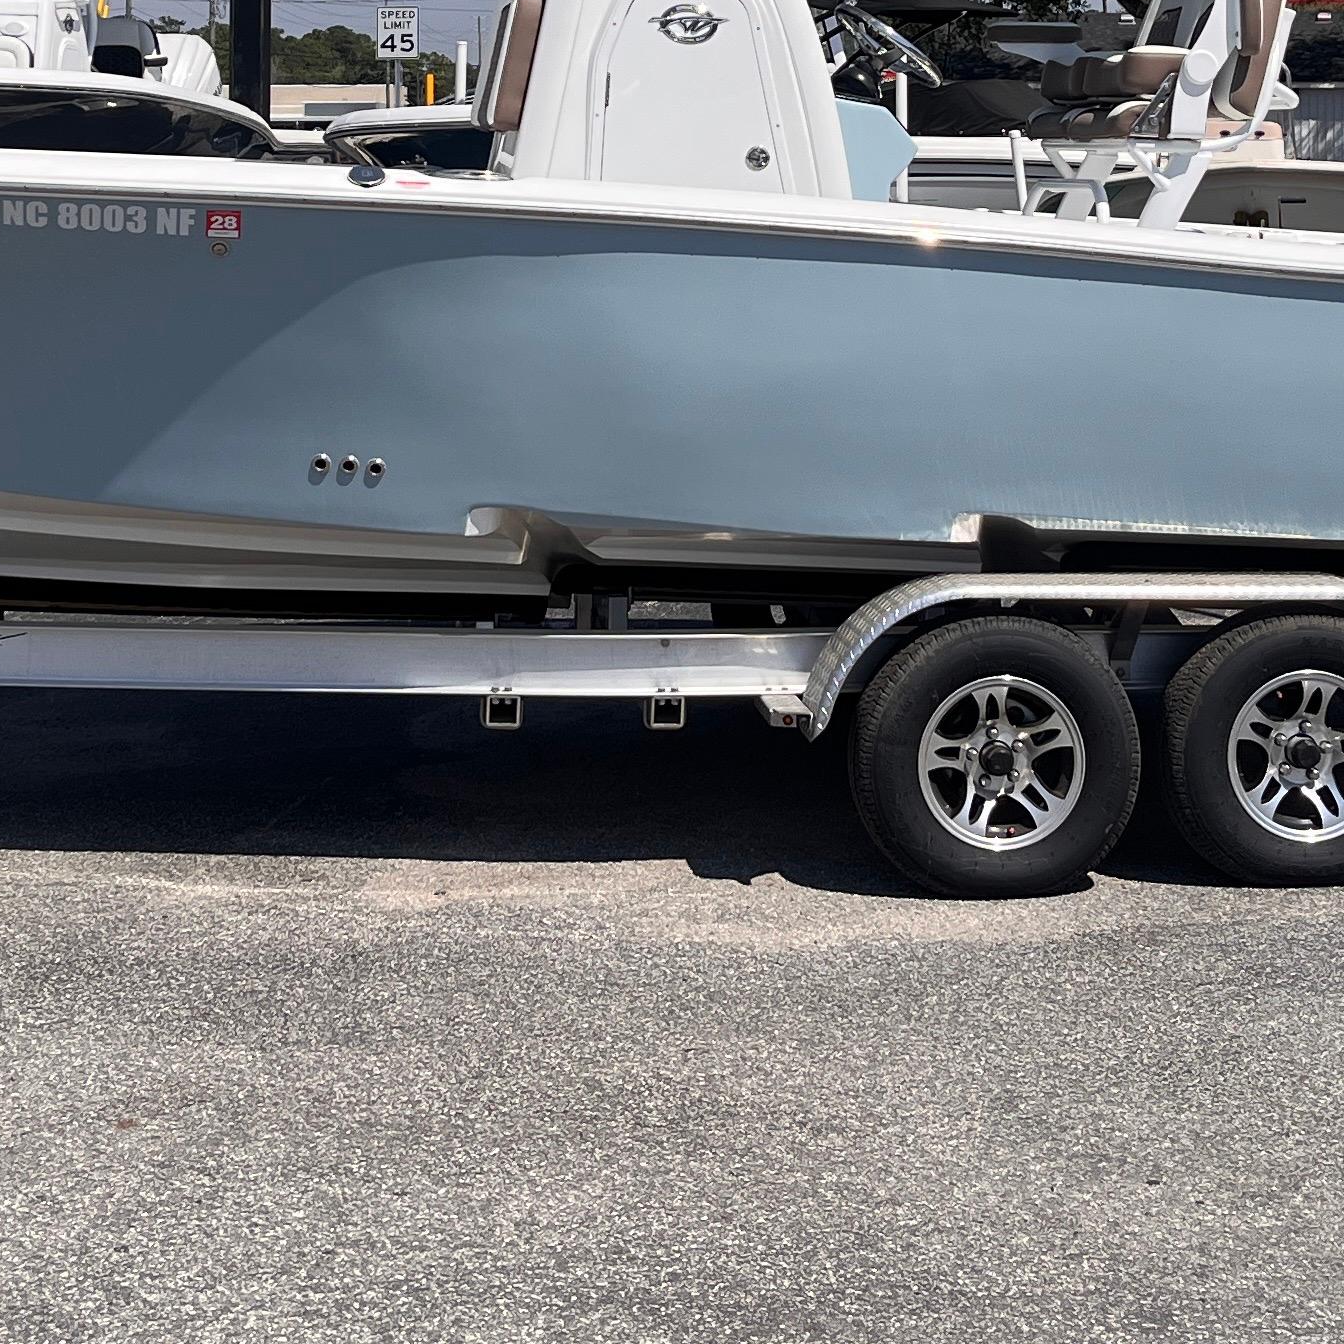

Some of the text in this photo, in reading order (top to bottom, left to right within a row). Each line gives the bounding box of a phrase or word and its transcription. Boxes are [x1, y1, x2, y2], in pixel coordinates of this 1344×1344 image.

[380, 10, 416, 19] SPEED
[383, 20, 412, 30] LIMIT
[379, 33, 415, 53] 45
[2, 199, 197, 237] NC 8003 NF
[209, 214, 238, 230] 28
